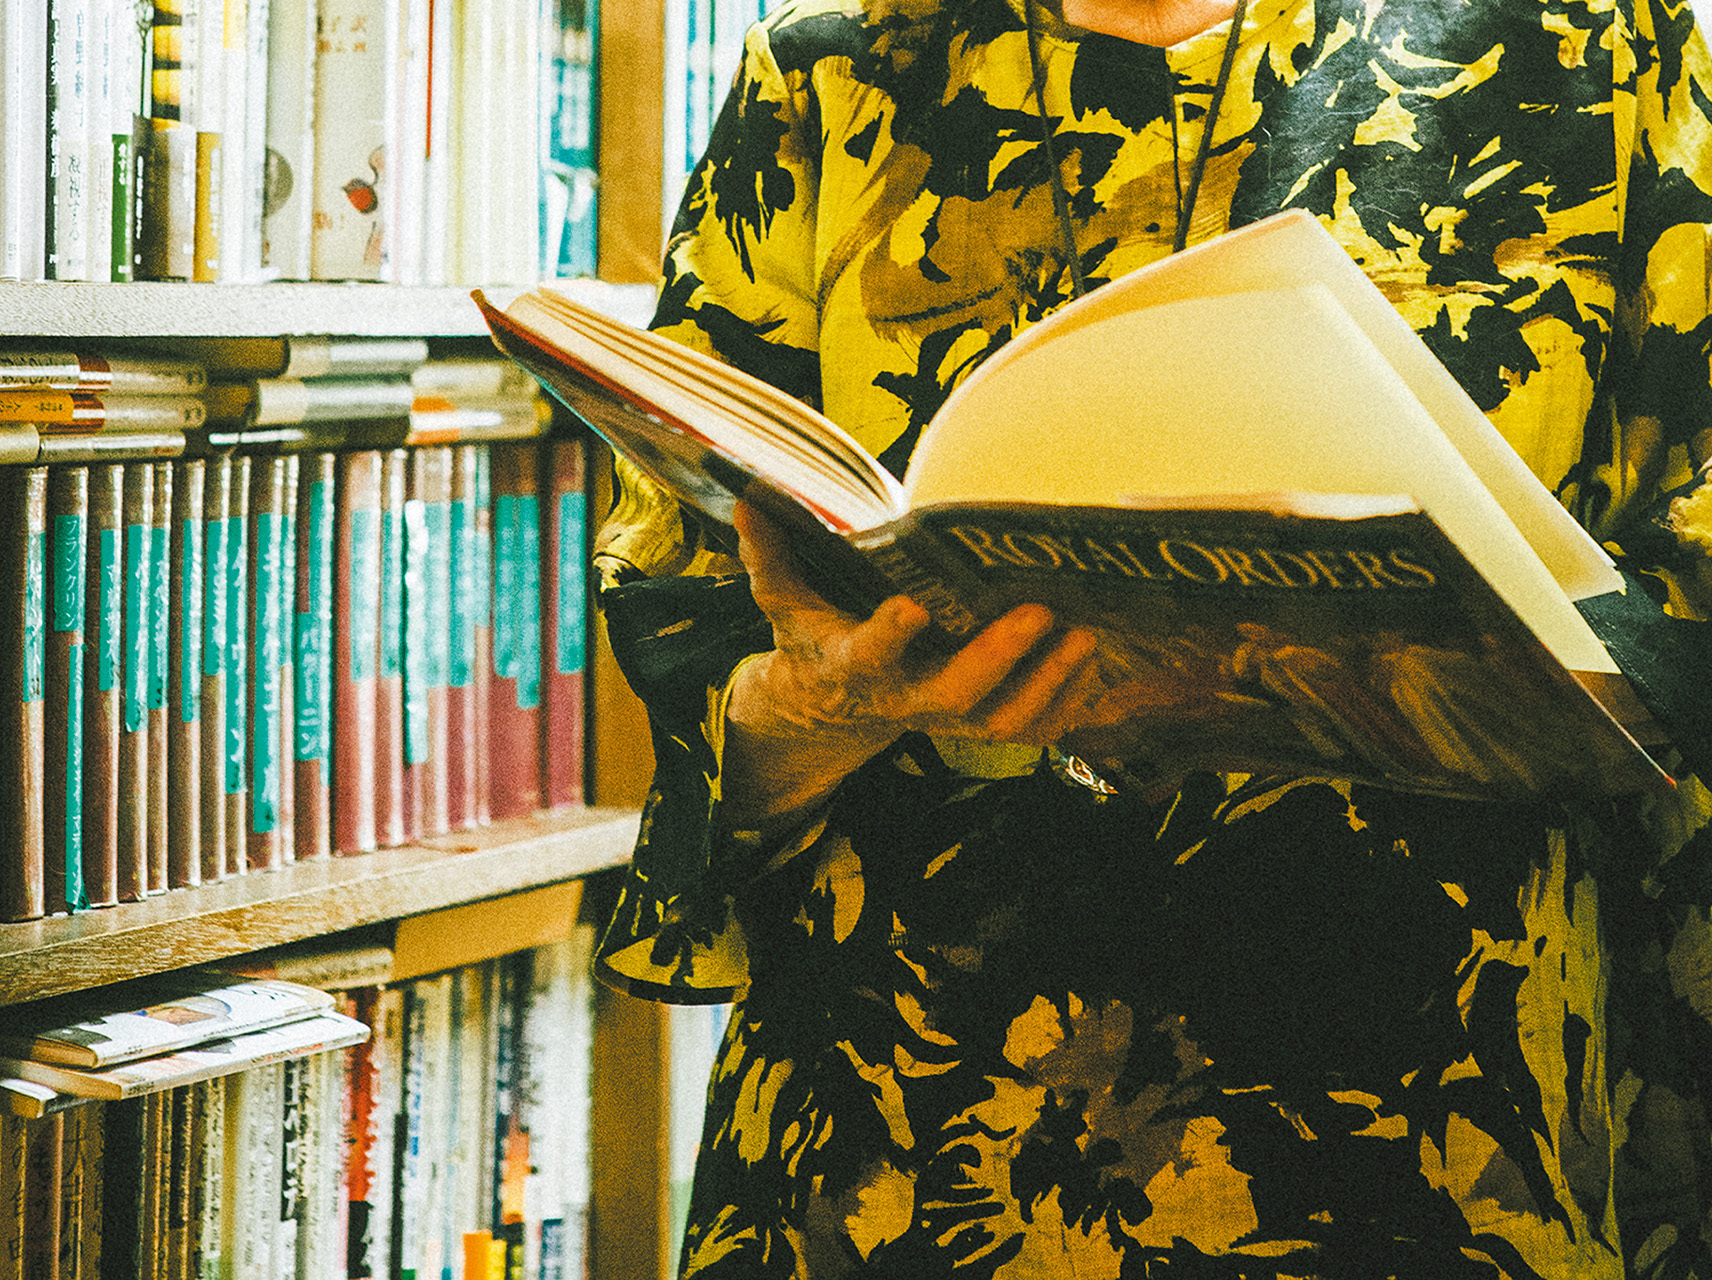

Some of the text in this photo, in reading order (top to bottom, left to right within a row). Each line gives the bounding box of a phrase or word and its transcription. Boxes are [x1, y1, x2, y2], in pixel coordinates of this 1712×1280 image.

[65, 519, 78, 628] フランクリン
[949, 525, 1172, 581] ROYAL
[1159, 540, 1436, 589] ORDERS
